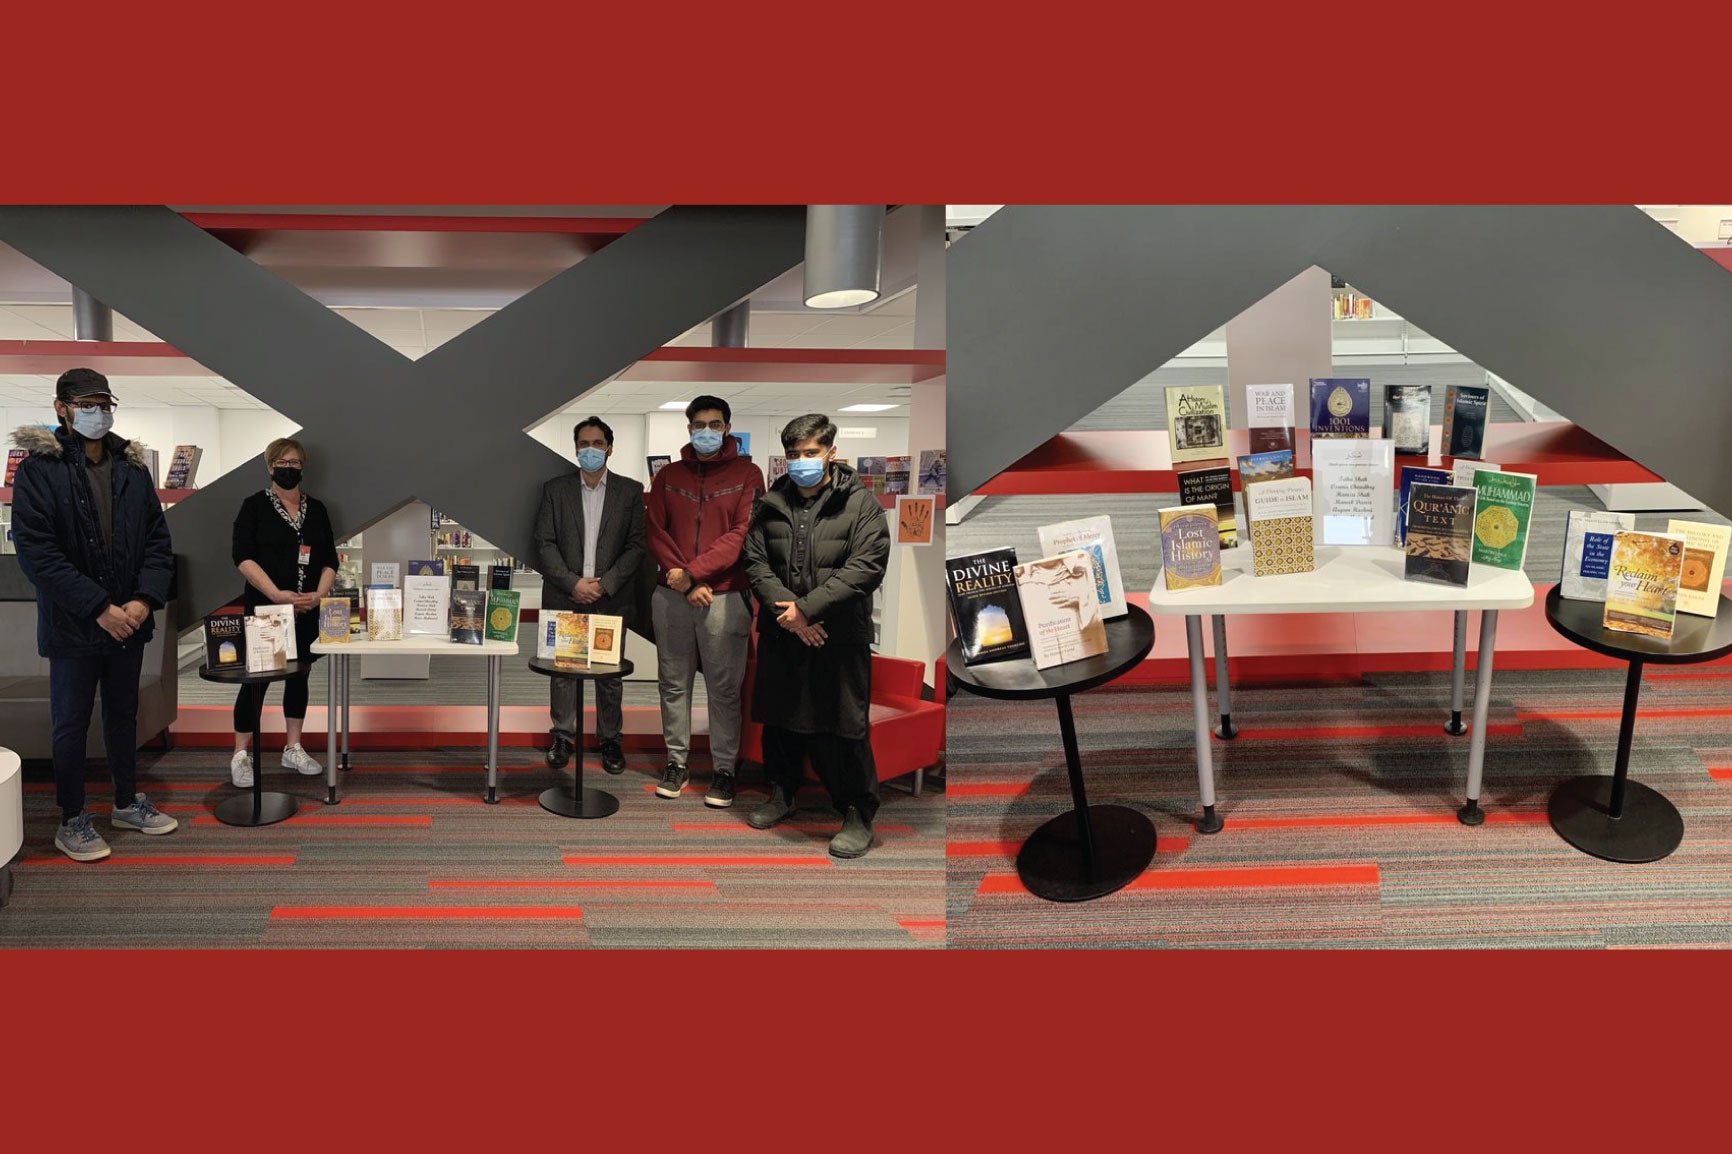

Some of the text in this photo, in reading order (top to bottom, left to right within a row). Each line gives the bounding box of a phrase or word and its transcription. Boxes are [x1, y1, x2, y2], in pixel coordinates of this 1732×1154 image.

[1178, 393, 1192, 410] A
[1255, 397, 1286, 405] PEACE
[1329, 417, 1351, 426] 1001
[1315, 424, 1366, 433] INVENTIONS
[1183, 476, 1204, 486] WHAT
[1184, 483, 1230, 495] IS THE ORIGIN
[1477, 485, 1531, 502] MUHAMMAD
[1254, 496, 1279, 504] GUIDE
[1285, 494, 1309, 502] ISLAM
[1424, 515, 1456, 526] TEXT
[1178, 528, 1204, 540] Lost
[1053, 535, 1076, 546] Prophet
[1171, 539, 1213, 551] Islamic
[973, 557, 986, 565] THE
[1170, 550, 1214, 562] History
[1584, 556, 1608, 565] Economy
[952, 560, 1011, 582] DIVINE
[1614, 565, 1658, 582] Reclaim
[955, 572, 1013, 594] REALITY
[1620, 580, 1637, 590] your
[1635, 579, 1668, 596] Heart
[210, 619, 240, 628] DIVINE
[1037, 616, 1072, 630] Purification
[1052, 624, 1071, 633] Heart
[210, 625, 241, 633] REALITY
